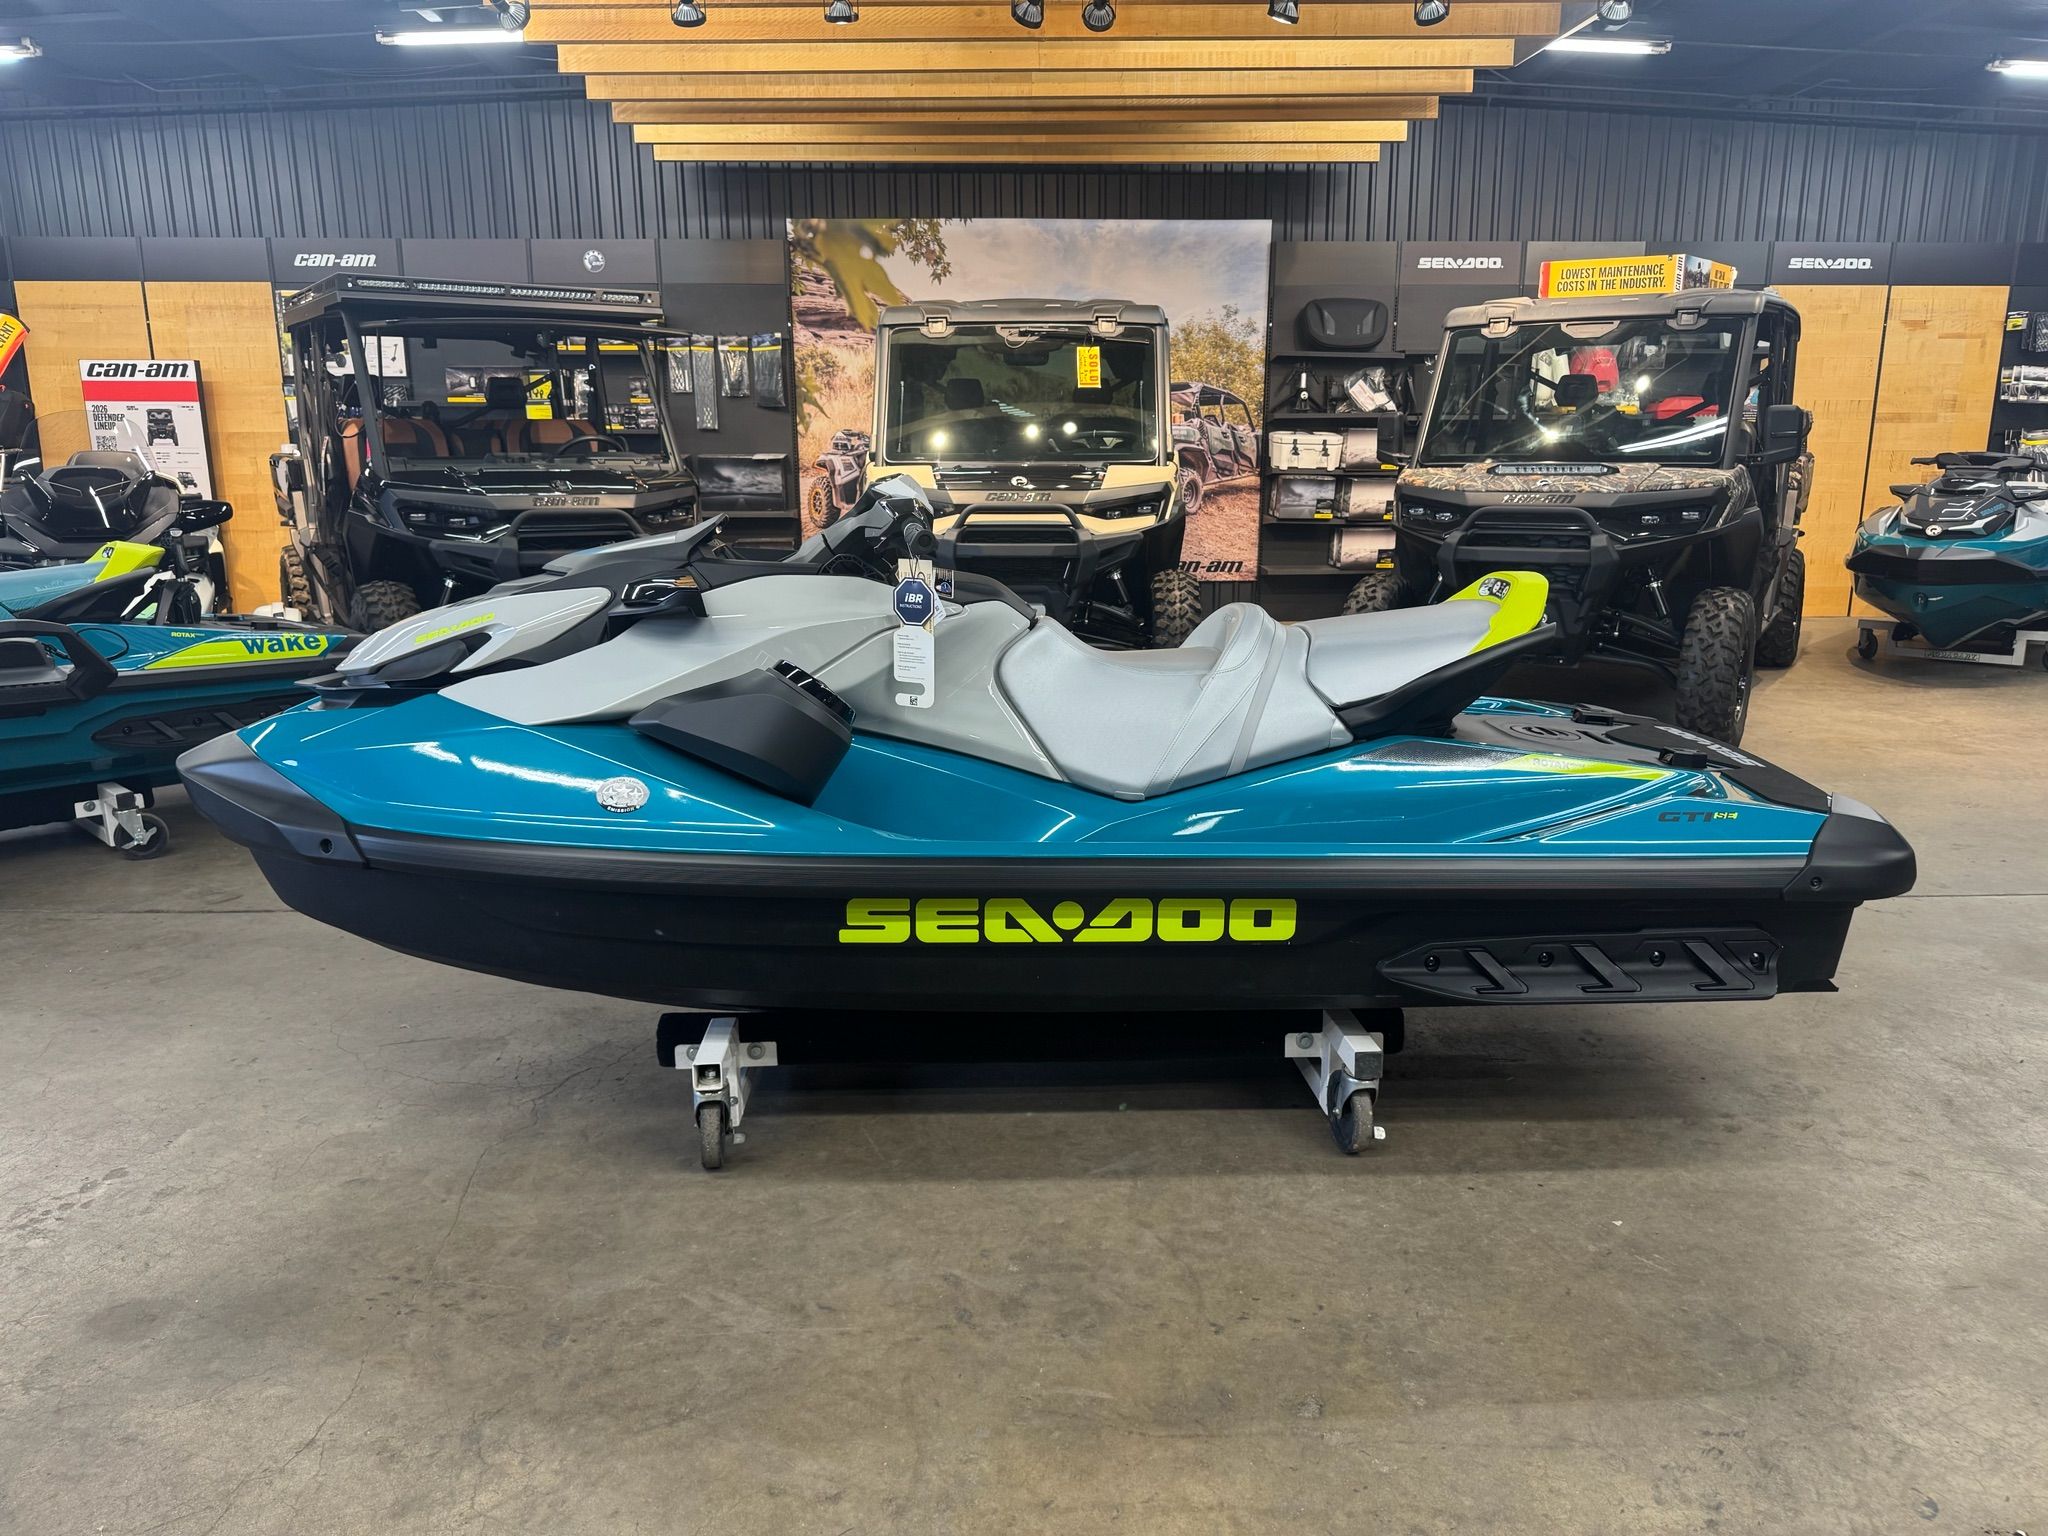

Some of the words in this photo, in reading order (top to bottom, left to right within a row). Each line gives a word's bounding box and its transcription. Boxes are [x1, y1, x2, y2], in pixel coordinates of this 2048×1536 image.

[294, 253, 375, 267] can-am
[1561, 267, 1596, 280] LOWEST
[1598, 264, 1664, 278] MAINTENANCE
[1557, 280, 1585, 292] COSTS
[1587, 280, 1597, 291] IN
[1600, 279, 1617, 290] THE
[1619, 276, 1666, 290] INDUSTRY.
[87, 363, 188, 378] can-am
[1089, 354, 1099, 382] SOLD
[91, 404, 108, 414] 2026
[93, 413, 125, 421] DEFENDER
[94, 421, 117, 431] LINEUP
[1179, 560, 1244, 573] an-am
[904, 592, 924, 604] iBR
[171, 631, 196, 639] ROTAX
